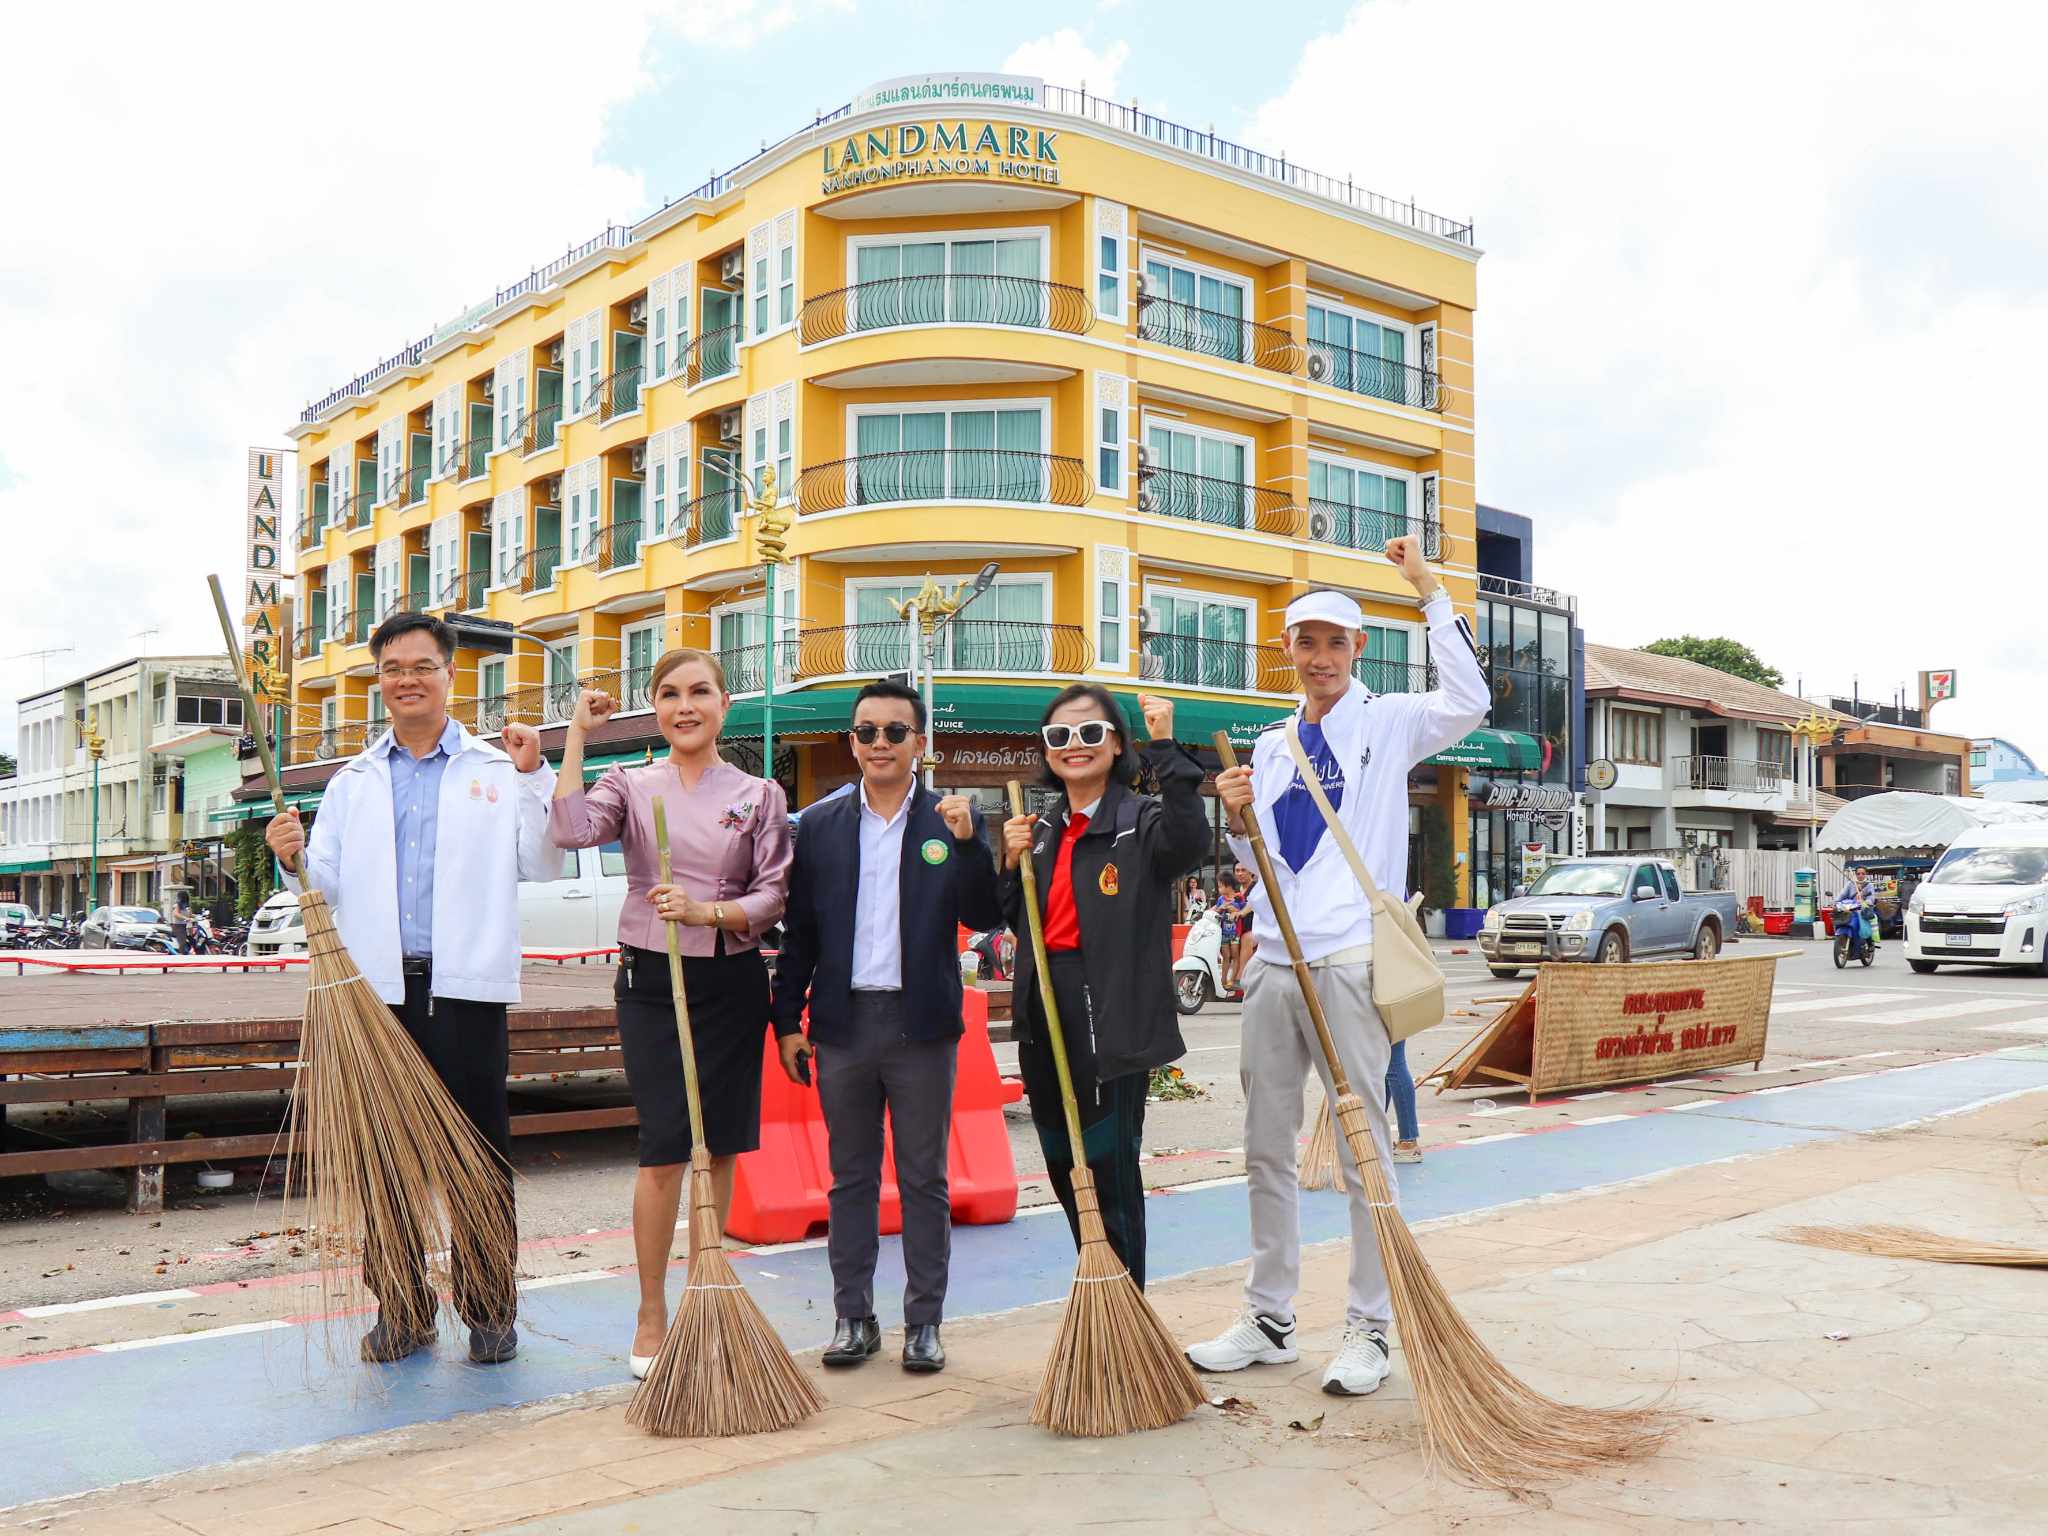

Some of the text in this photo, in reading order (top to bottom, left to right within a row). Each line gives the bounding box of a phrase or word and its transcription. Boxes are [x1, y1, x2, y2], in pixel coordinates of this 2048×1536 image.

[822, 120, 1058, 174] LANDMARK
[821, 157, 1062, 195] NAKHONPHANOM HOTEL
[249, 453, 278, 697] LANDMARK
[938, 720, 965, 729] JUICE
